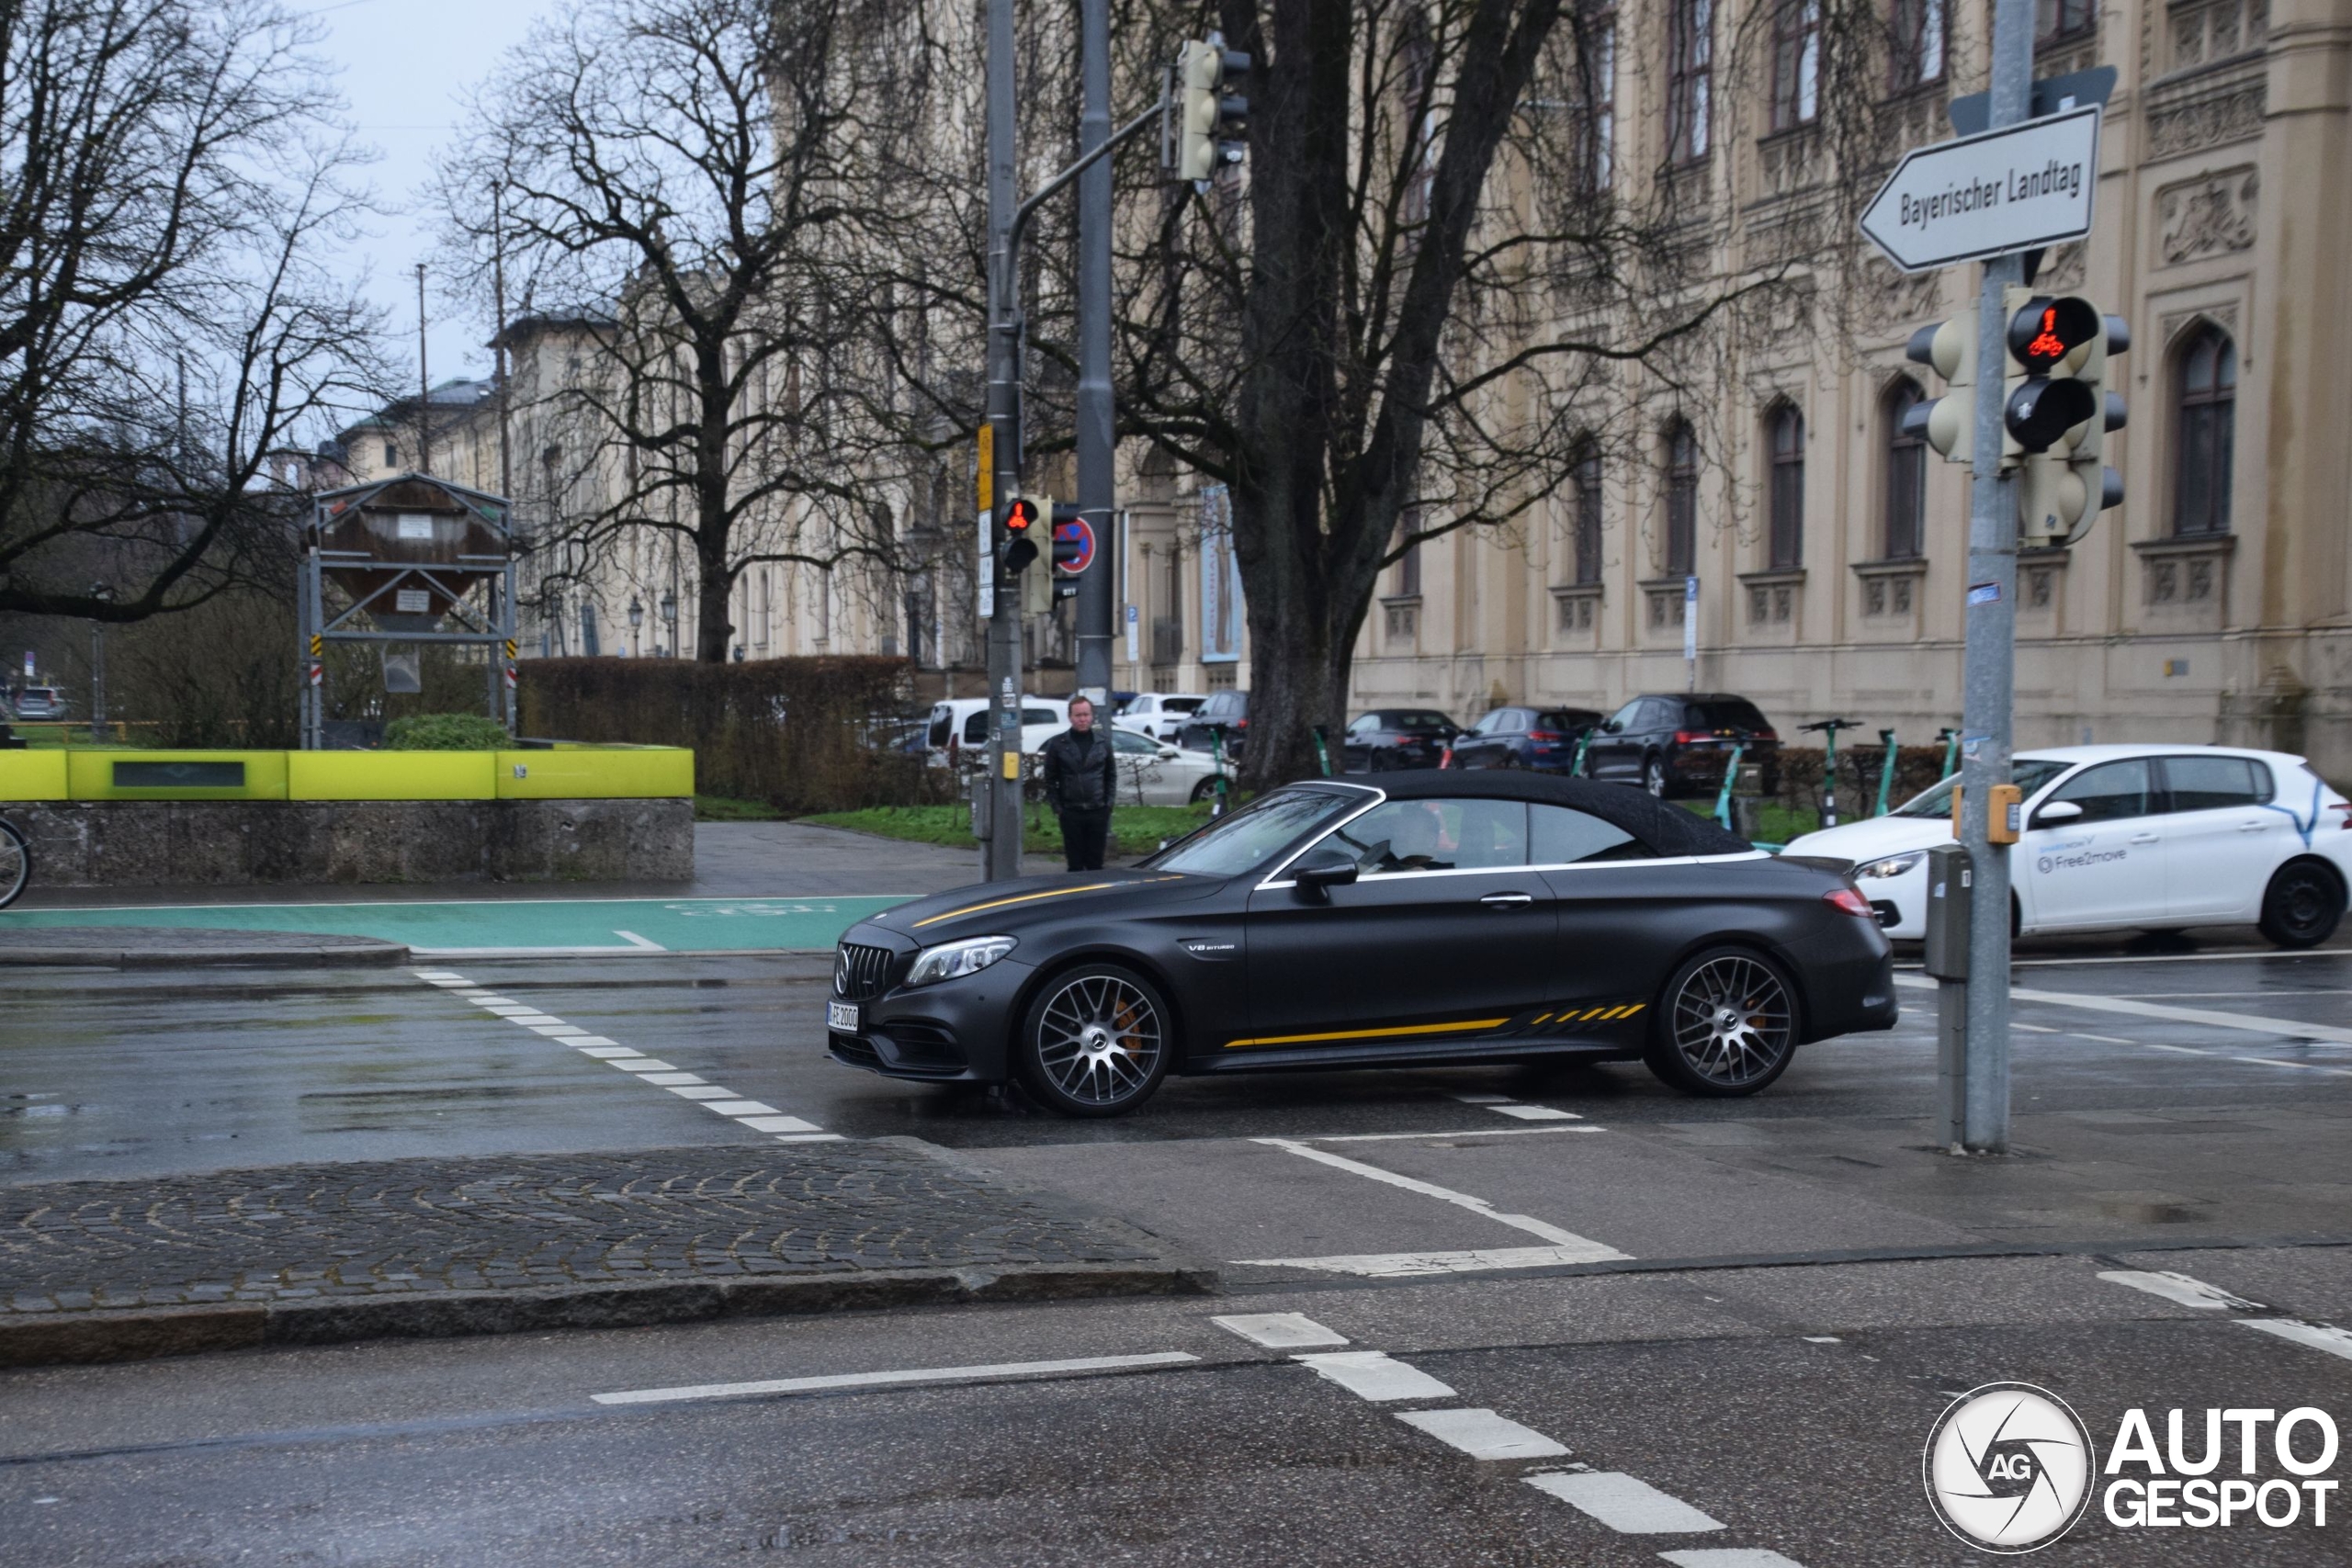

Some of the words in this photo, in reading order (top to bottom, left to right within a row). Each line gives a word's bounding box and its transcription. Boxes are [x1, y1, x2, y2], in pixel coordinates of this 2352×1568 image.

[1900, 176, 2003, 231] Bayerischer
[2007, 159, 2082, 199] Landtag
[2054, 849, 2127, 869] Free2move
